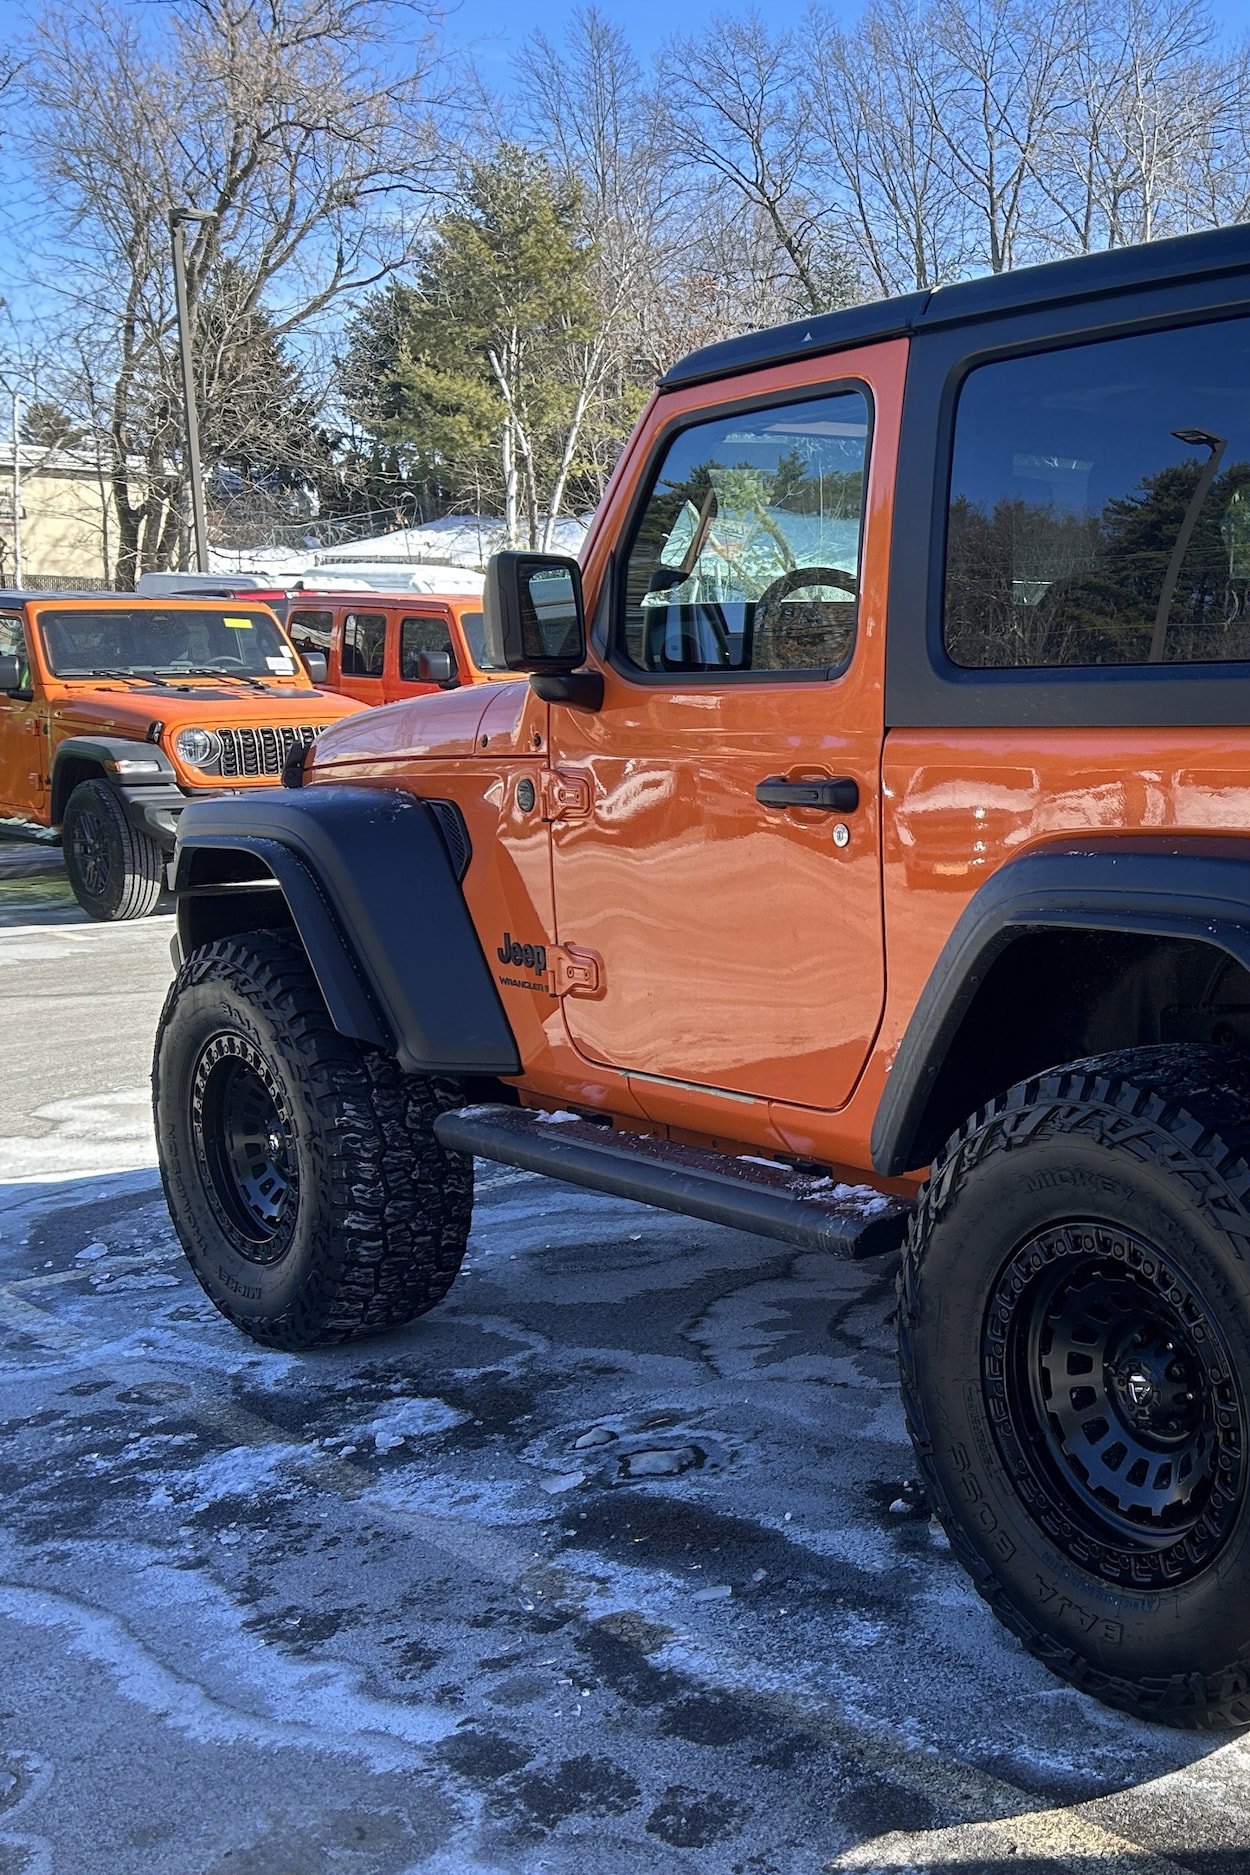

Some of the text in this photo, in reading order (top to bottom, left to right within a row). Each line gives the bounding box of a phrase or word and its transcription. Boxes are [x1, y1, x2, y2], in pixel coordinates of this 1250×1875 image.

[498, 932, 546, 976] Jeep
[499, 976, 544, 991] WRANGLER
[1020, 1165, 1137, 1202] MICKEY
[946, 1440, 1017, 1563] BOSS
[1034, 1573, 1124, 1648] BAJA
